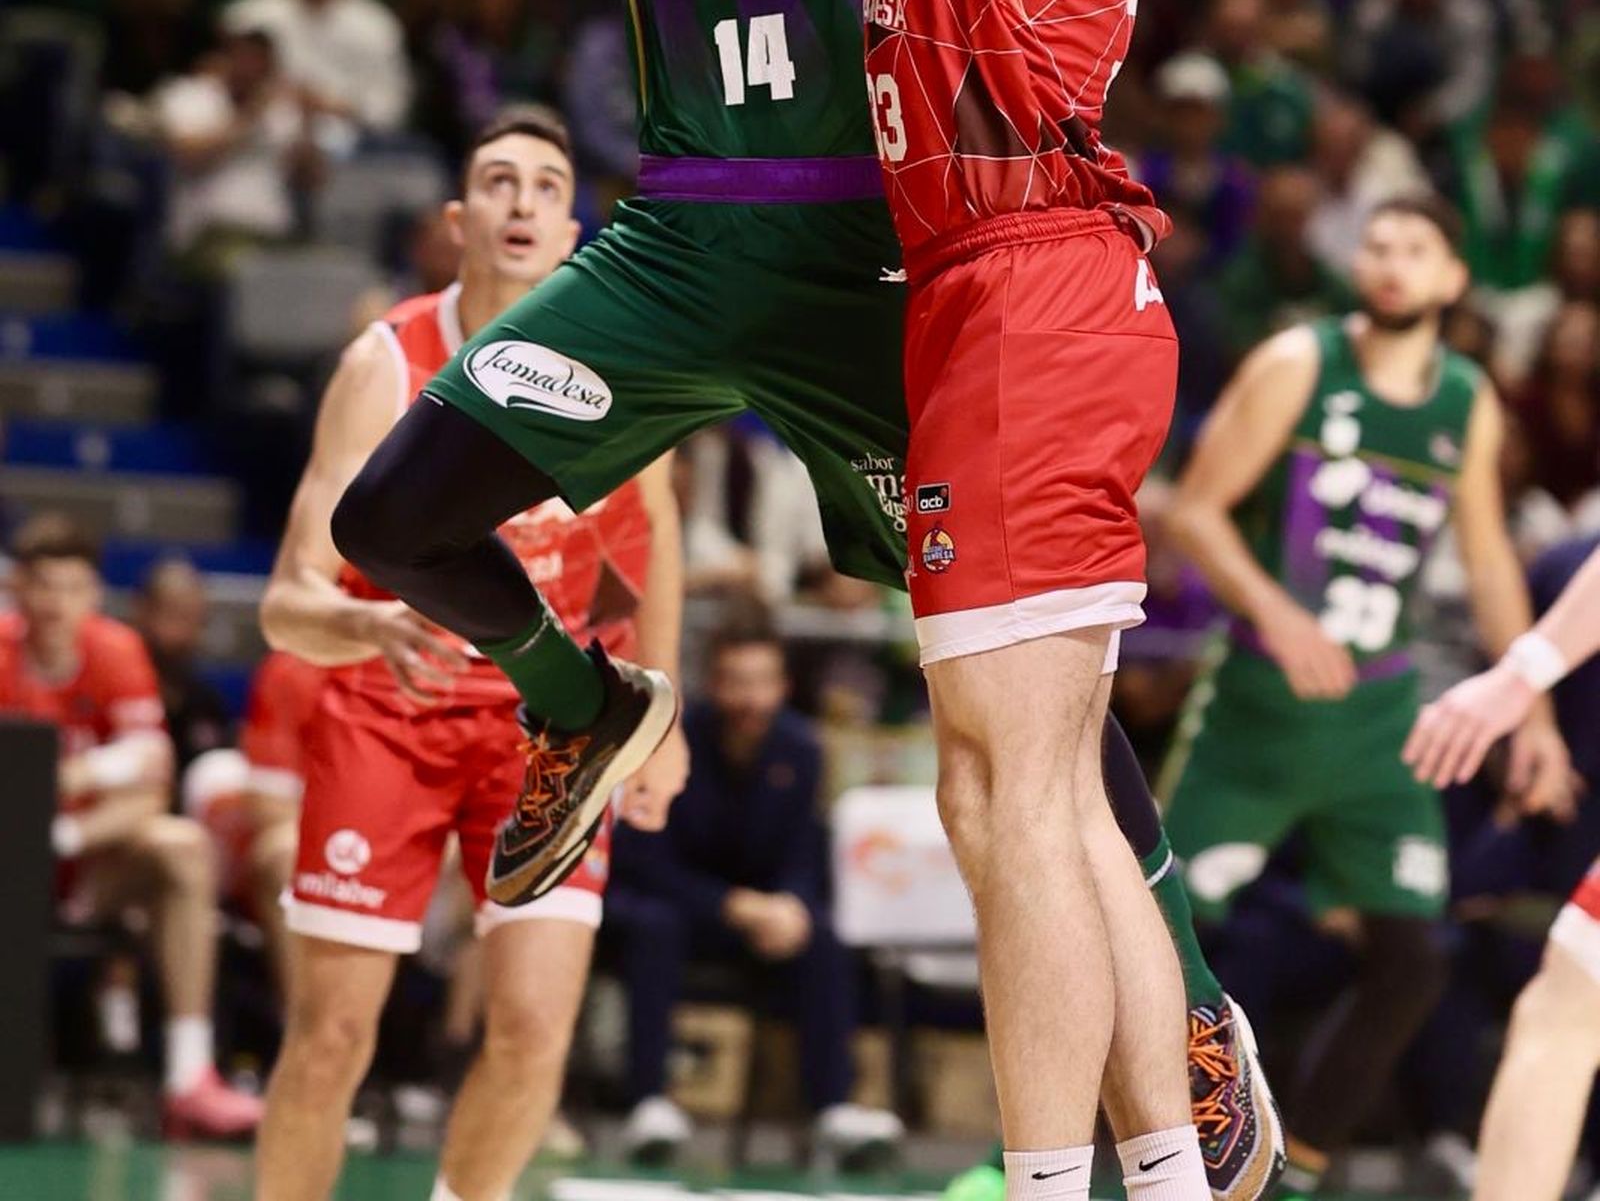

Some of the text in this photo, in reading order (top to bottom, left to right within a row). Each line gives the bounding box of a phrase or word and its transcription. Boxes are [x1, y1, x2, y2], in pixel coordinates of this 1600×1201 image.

[713, 13, 796, 106] 14
[850, 452, 894, 472] sabor
[920, 495, 944, 510] acb
